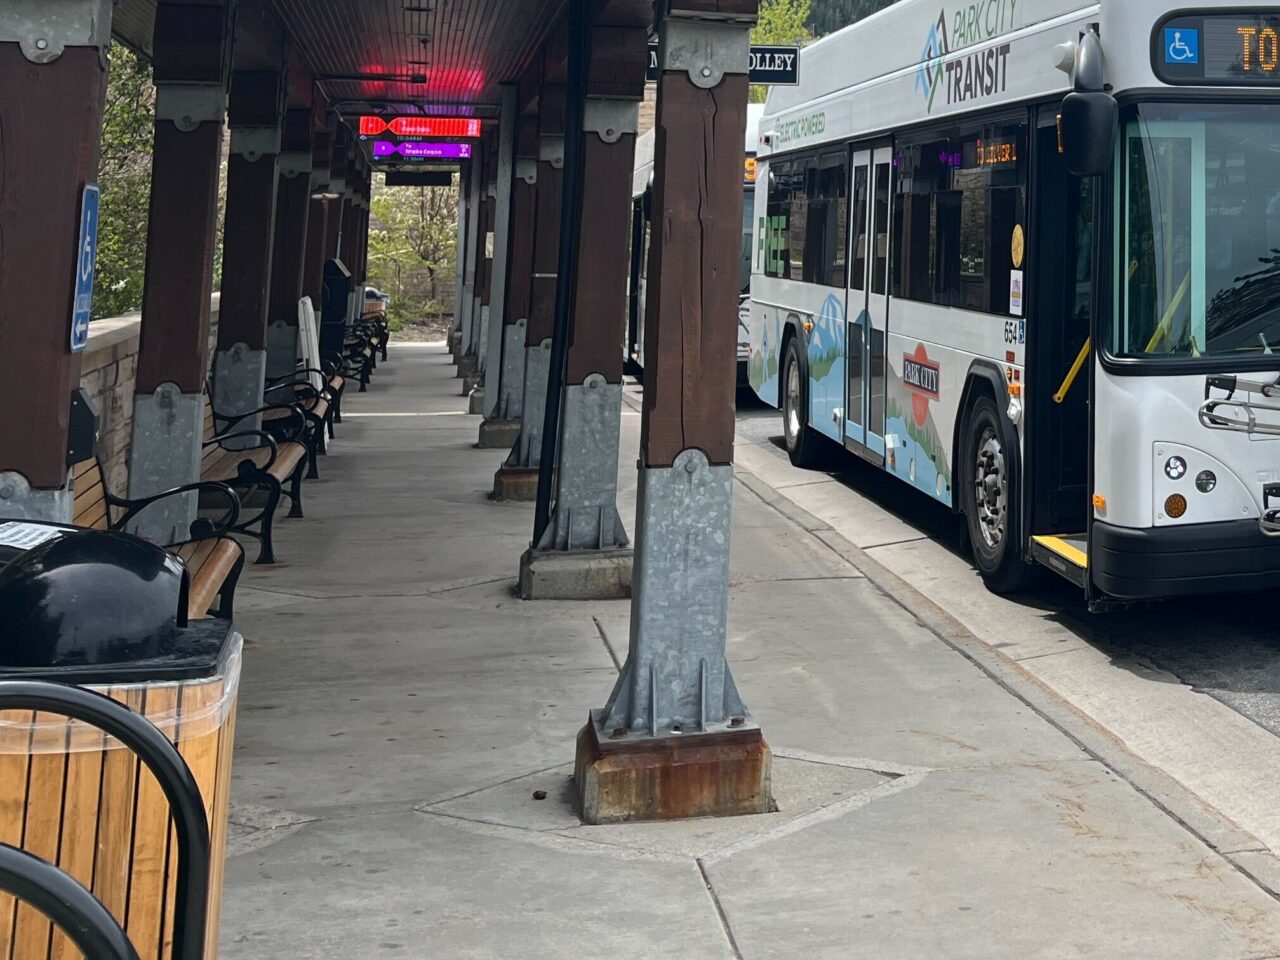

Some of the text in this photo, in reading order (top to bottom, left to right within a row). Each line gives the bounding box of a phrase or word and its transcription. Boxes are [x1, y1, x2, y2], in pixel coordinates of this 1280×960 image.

[952, 0, 985, 49] PARK
[749, 53, 795, 71] OLLEY
[1236, 27, 1278, 71] TO
[945, 43, 1011, 105] TRANSIT
[1004, 321, 1018, 344] 654
[904, 361, 938, 392] PARK CITY
